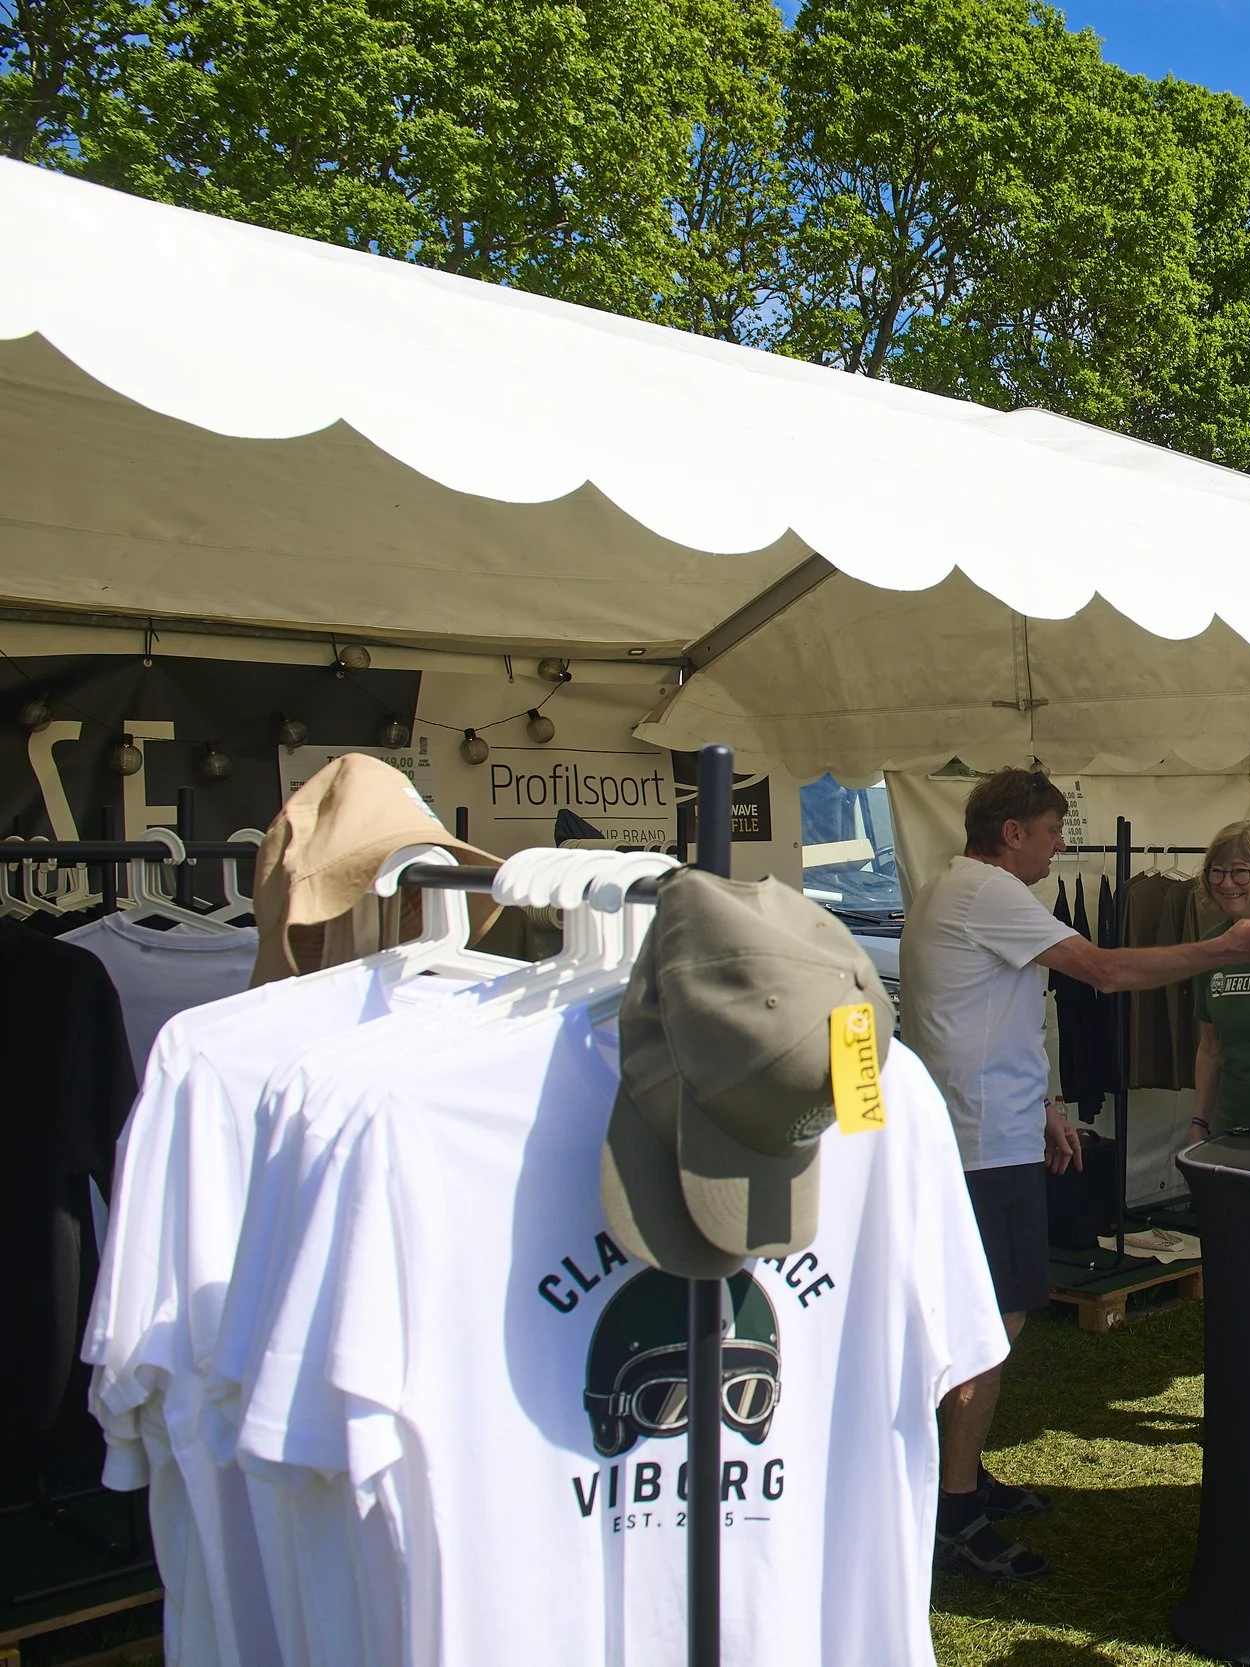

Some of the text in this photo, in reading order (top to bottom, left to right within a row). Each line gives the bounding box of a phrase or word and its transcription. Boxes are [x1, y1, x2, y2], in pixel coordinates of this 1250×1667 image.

[490, 763, 667, 813] Profilsport
[623, 829, 666, 842] BRAND
[731, 818, 760, 832] FILE
[762, 1252, 836, 1309] ACE
[613, 1511, 735, 1533] EST. 25
